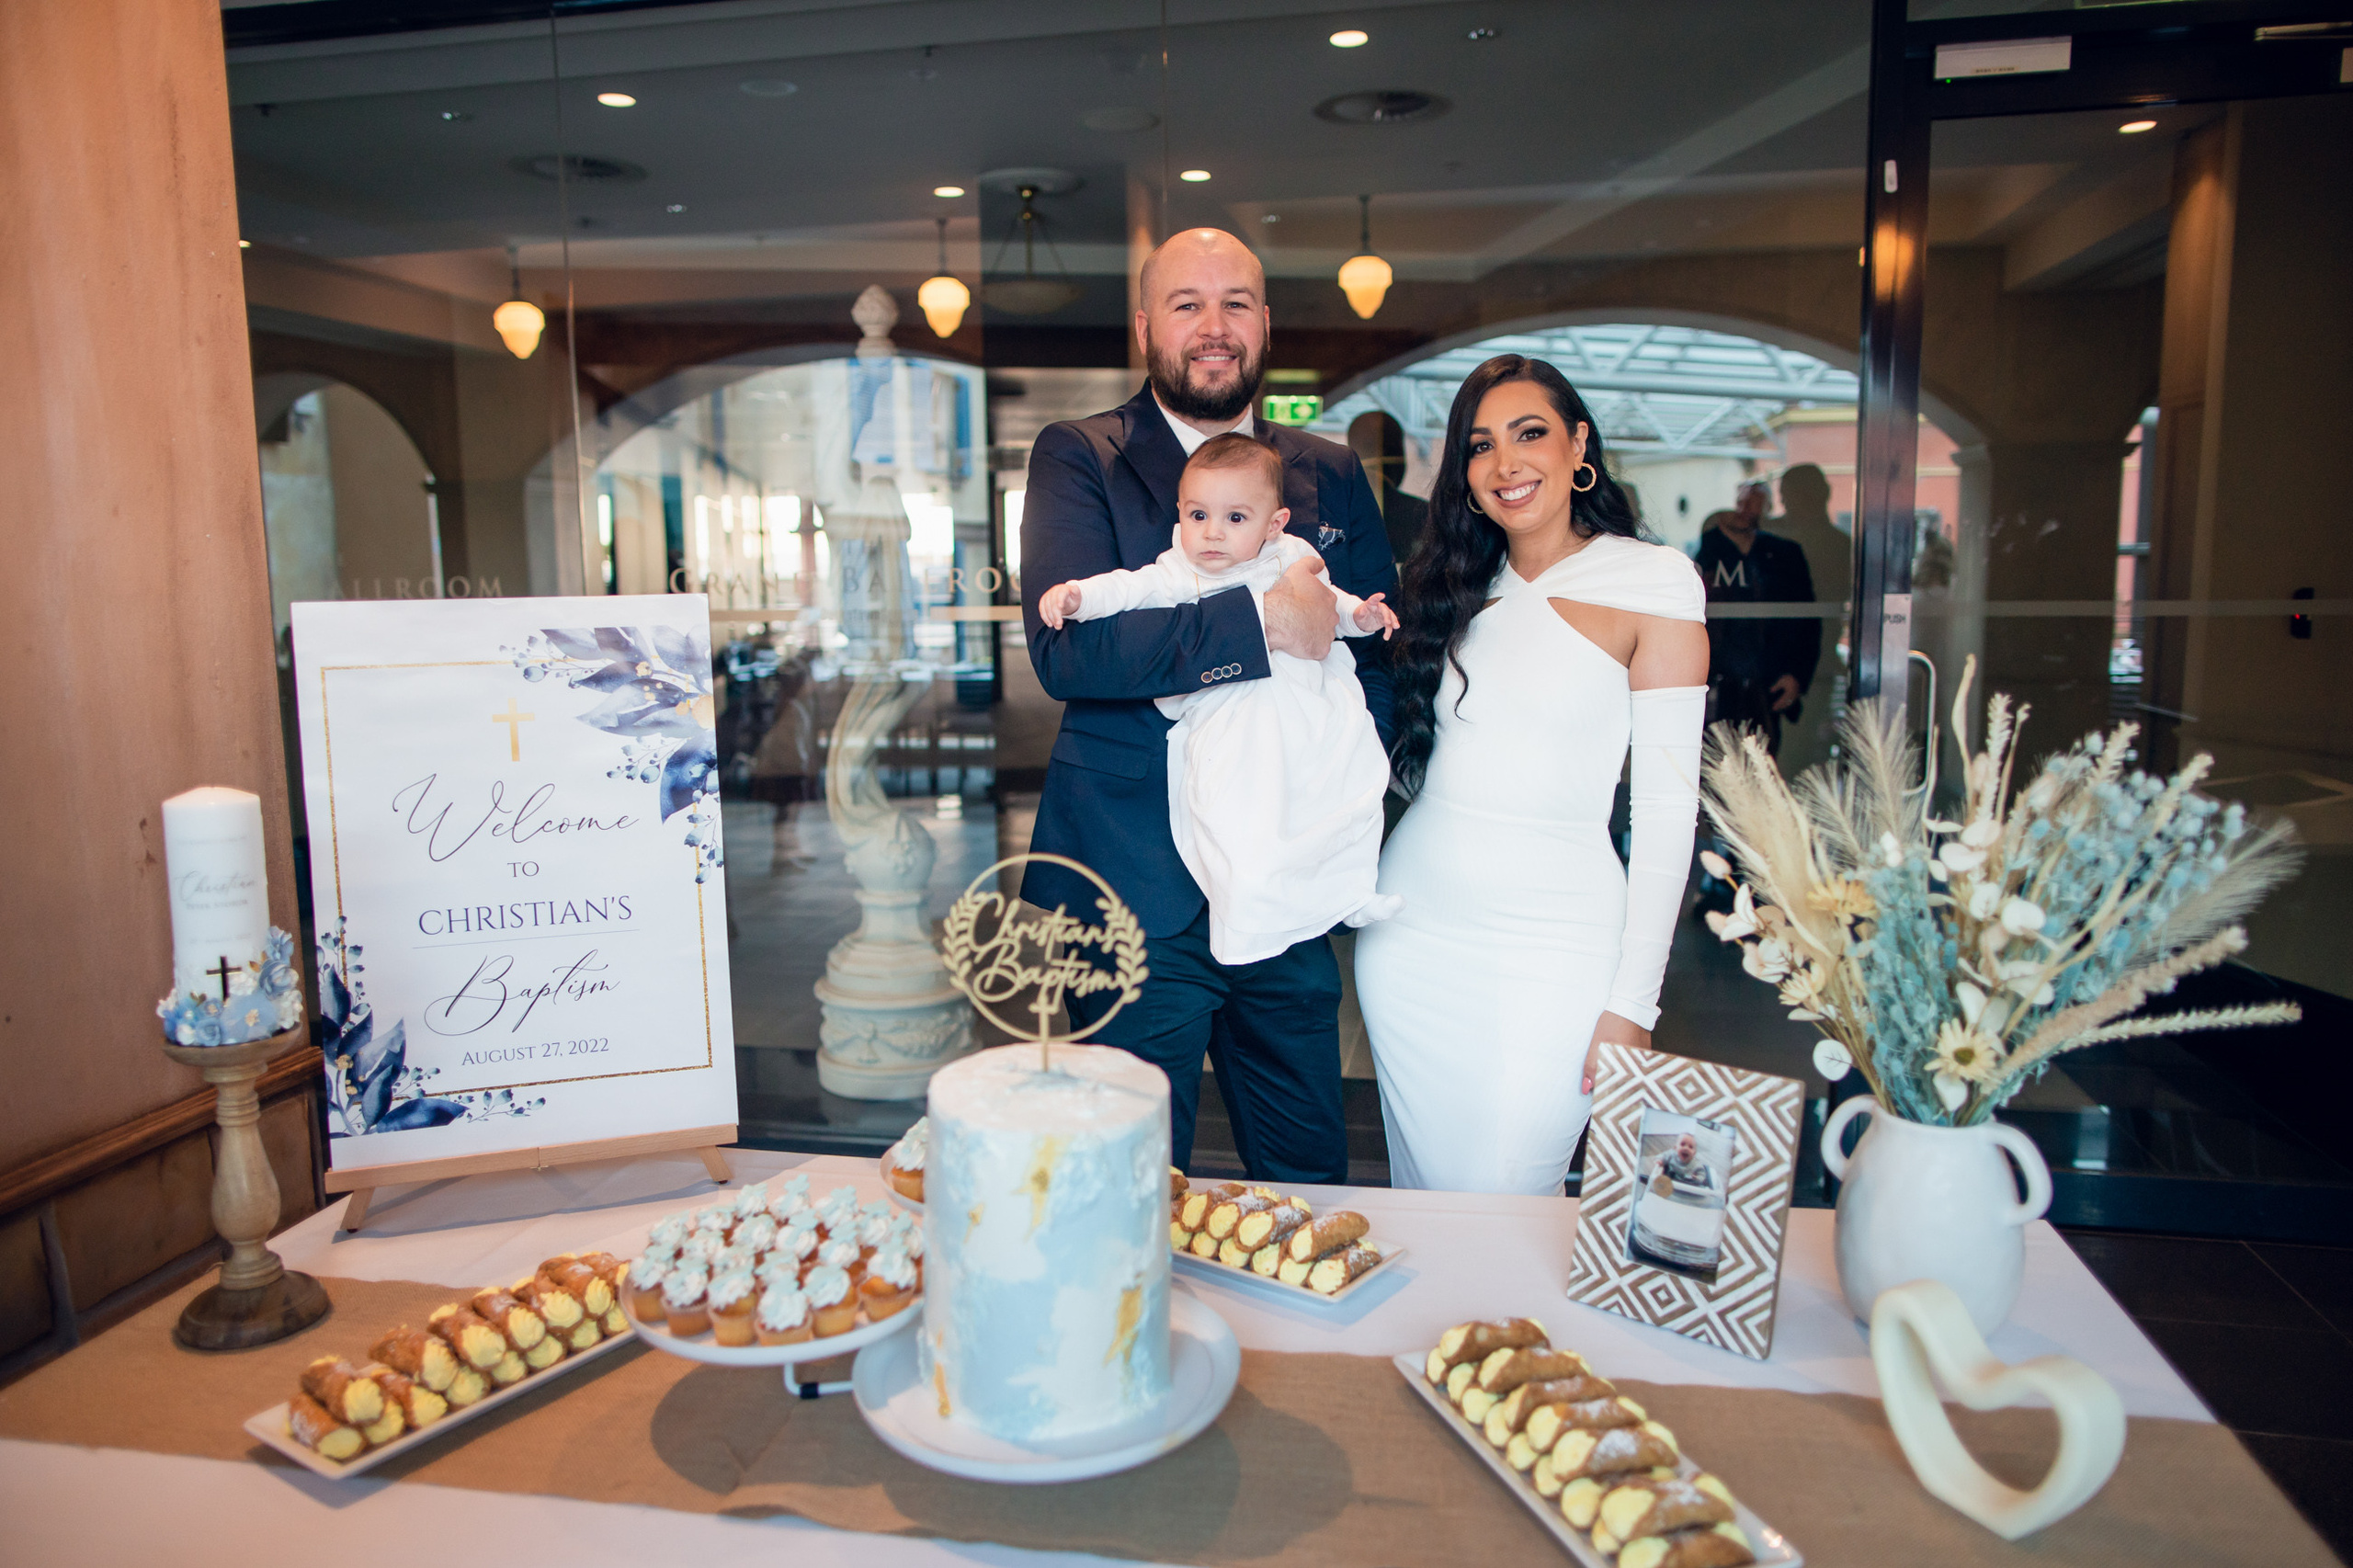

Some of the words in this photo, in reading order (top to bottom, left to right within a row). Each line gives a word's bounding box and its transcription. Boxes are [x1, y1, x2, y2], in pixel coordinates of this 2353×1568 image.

[392, 773, 639, 862] Welcome
[506, 860, 540, 878] TO
[418, 895, 633, 936] CHRISTIAN'S
[424, 949, 621, 1037] Baptism
[973, 938, 1121, 1015] Baptism
[461, 1046, 537, 1066] AUGUST
[567, 1037, 609, 1056] 2022
